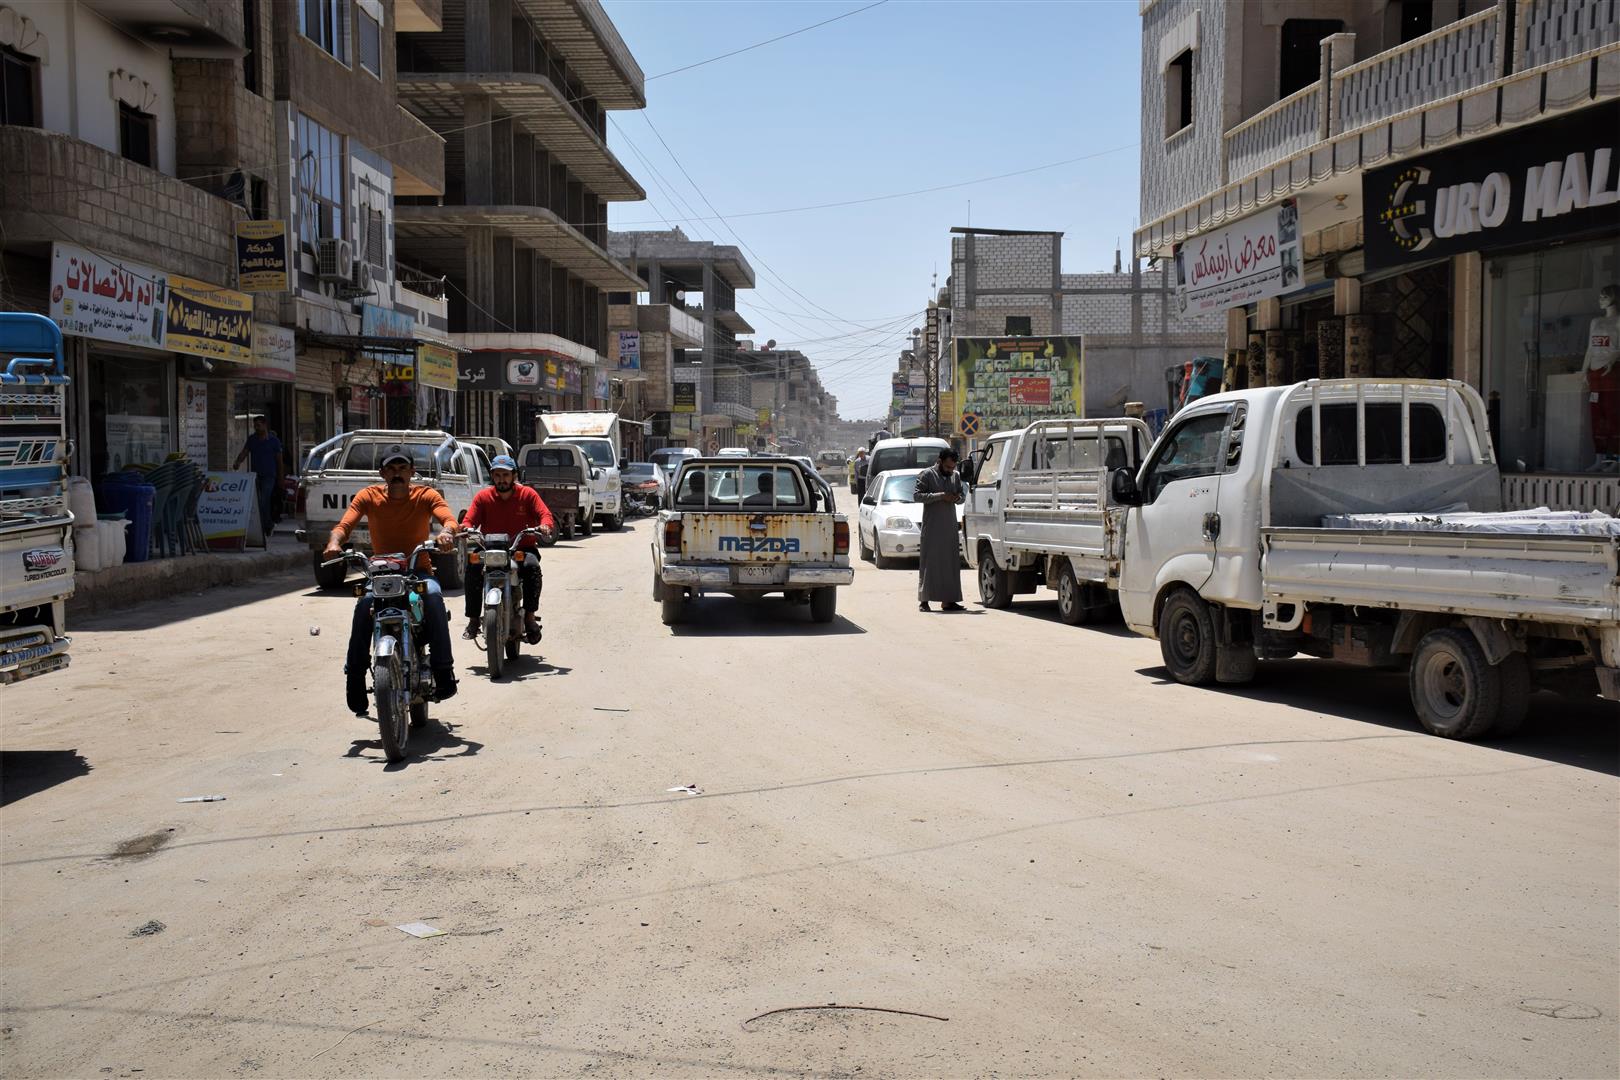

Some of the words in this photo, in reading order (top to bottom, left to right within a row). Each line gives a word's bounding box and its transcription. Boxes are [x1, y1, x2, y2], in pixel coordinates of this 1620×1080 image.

[1522, 148, 1620, 222] MAL
[246, 242, 274, 254] شركة
[1235, 235, 1276, 274] معرض
[217, 315, 239, 341] شركة
[27, 554, 57, 567] TURBO
